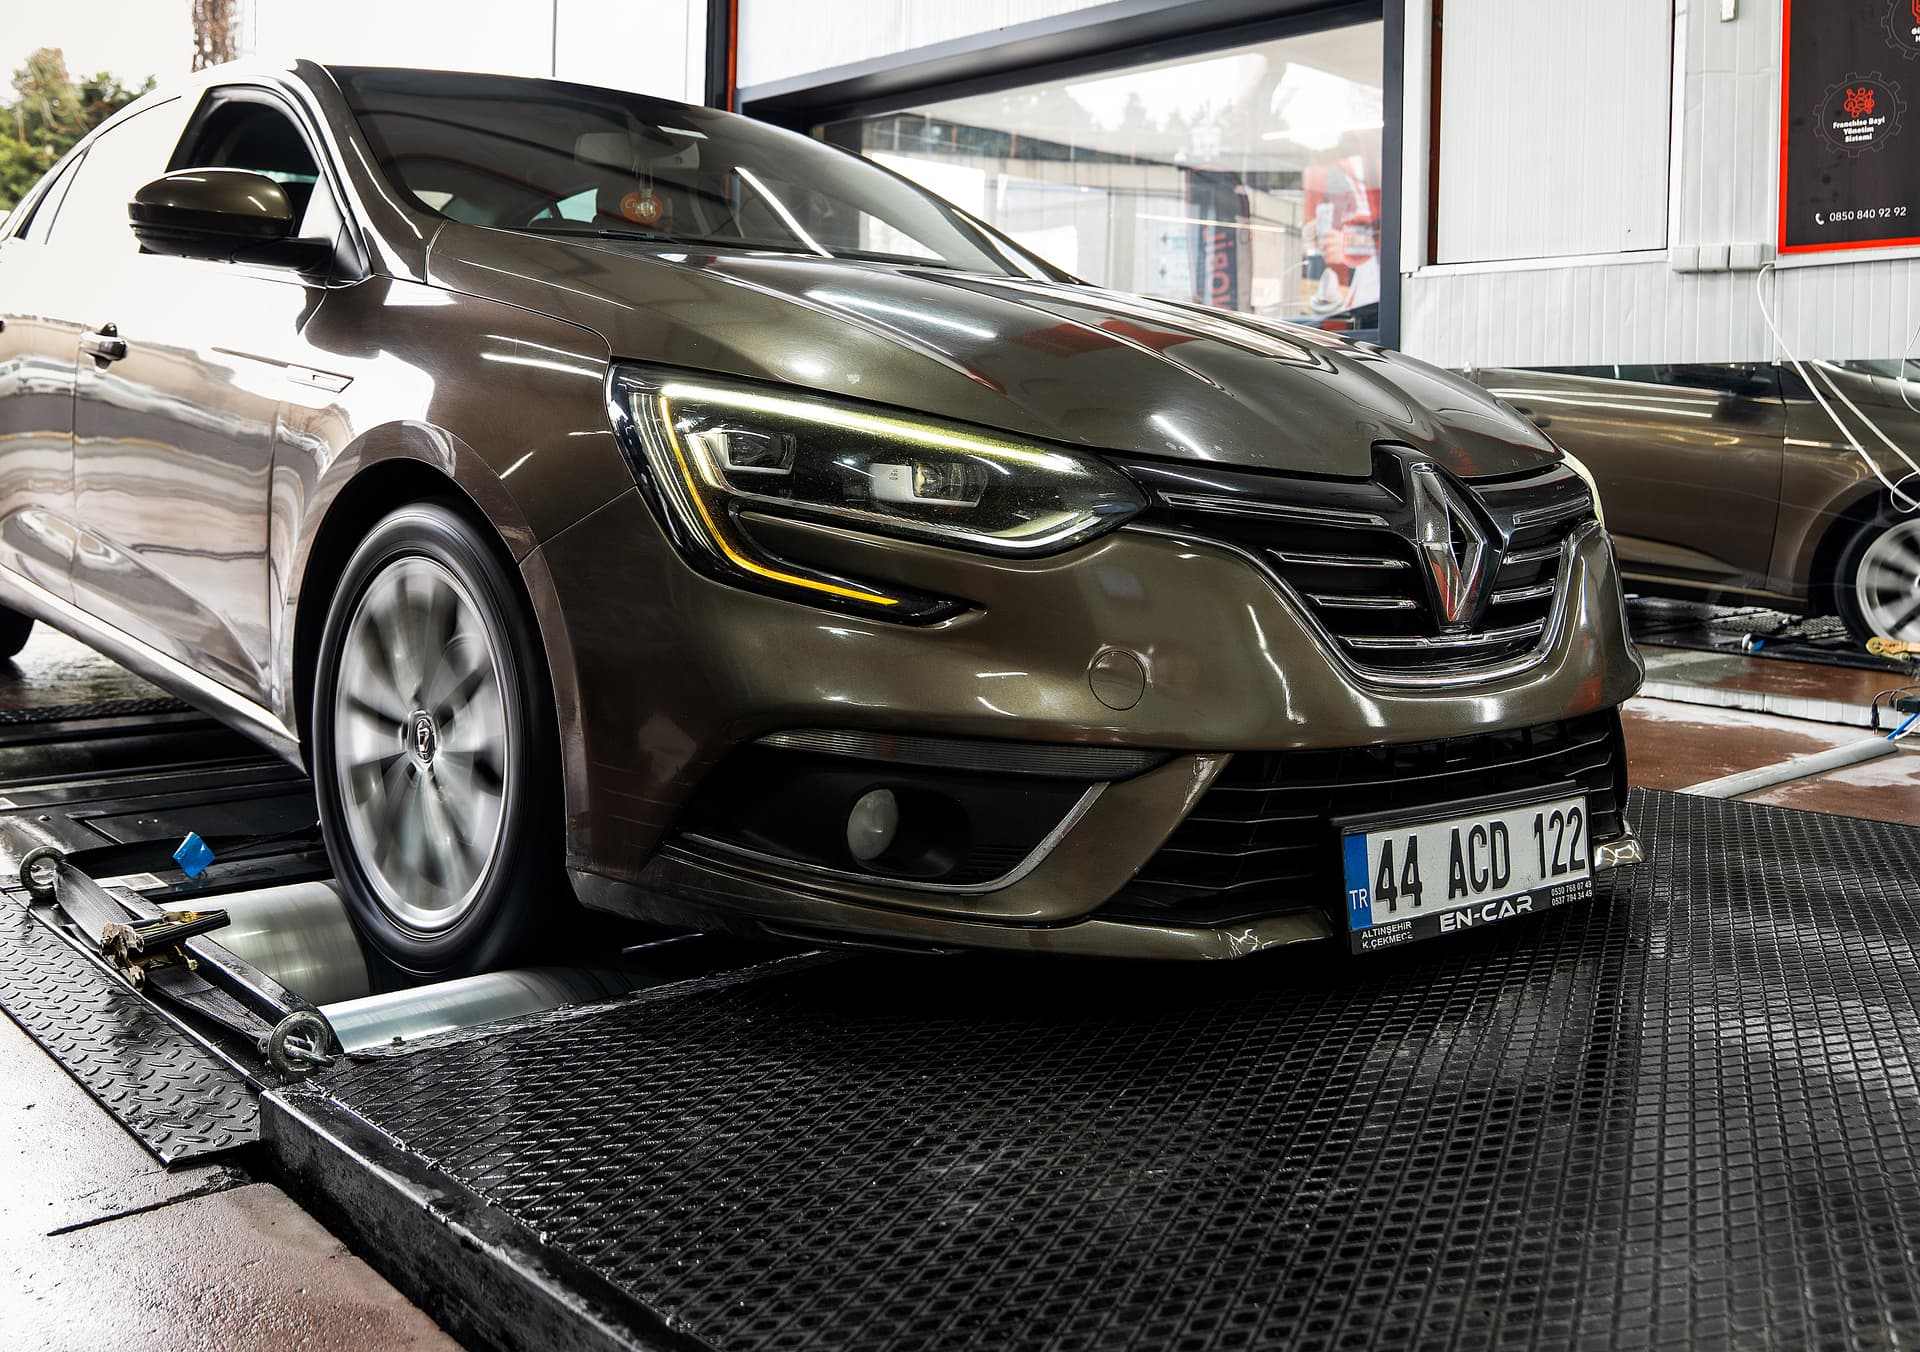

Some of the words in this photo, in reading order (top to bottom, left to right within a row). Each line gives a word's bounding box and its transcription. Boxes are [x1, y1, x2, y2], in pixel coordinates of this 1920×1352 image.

[1833, 119, 1867, 129] Franchise
[1843, 126, 1874, 135] Yönetim
[1845, 133, 1873, 142] Sistemi
[1829, 210, 1855, 222] 0850
[1857, 208, 1876, 220] 840
[1878, 207, 1891, 218] 92
[1894, 206, 1907, 217] 92
[1375, 833, 1423, 912] 44
[1448, 820, 1511, 900] ACD
[1533, 805, 1586, 880] 122
[1349, 888, 1369, 910] TR
[1440, 895, 1534, 933] EN-CAR
